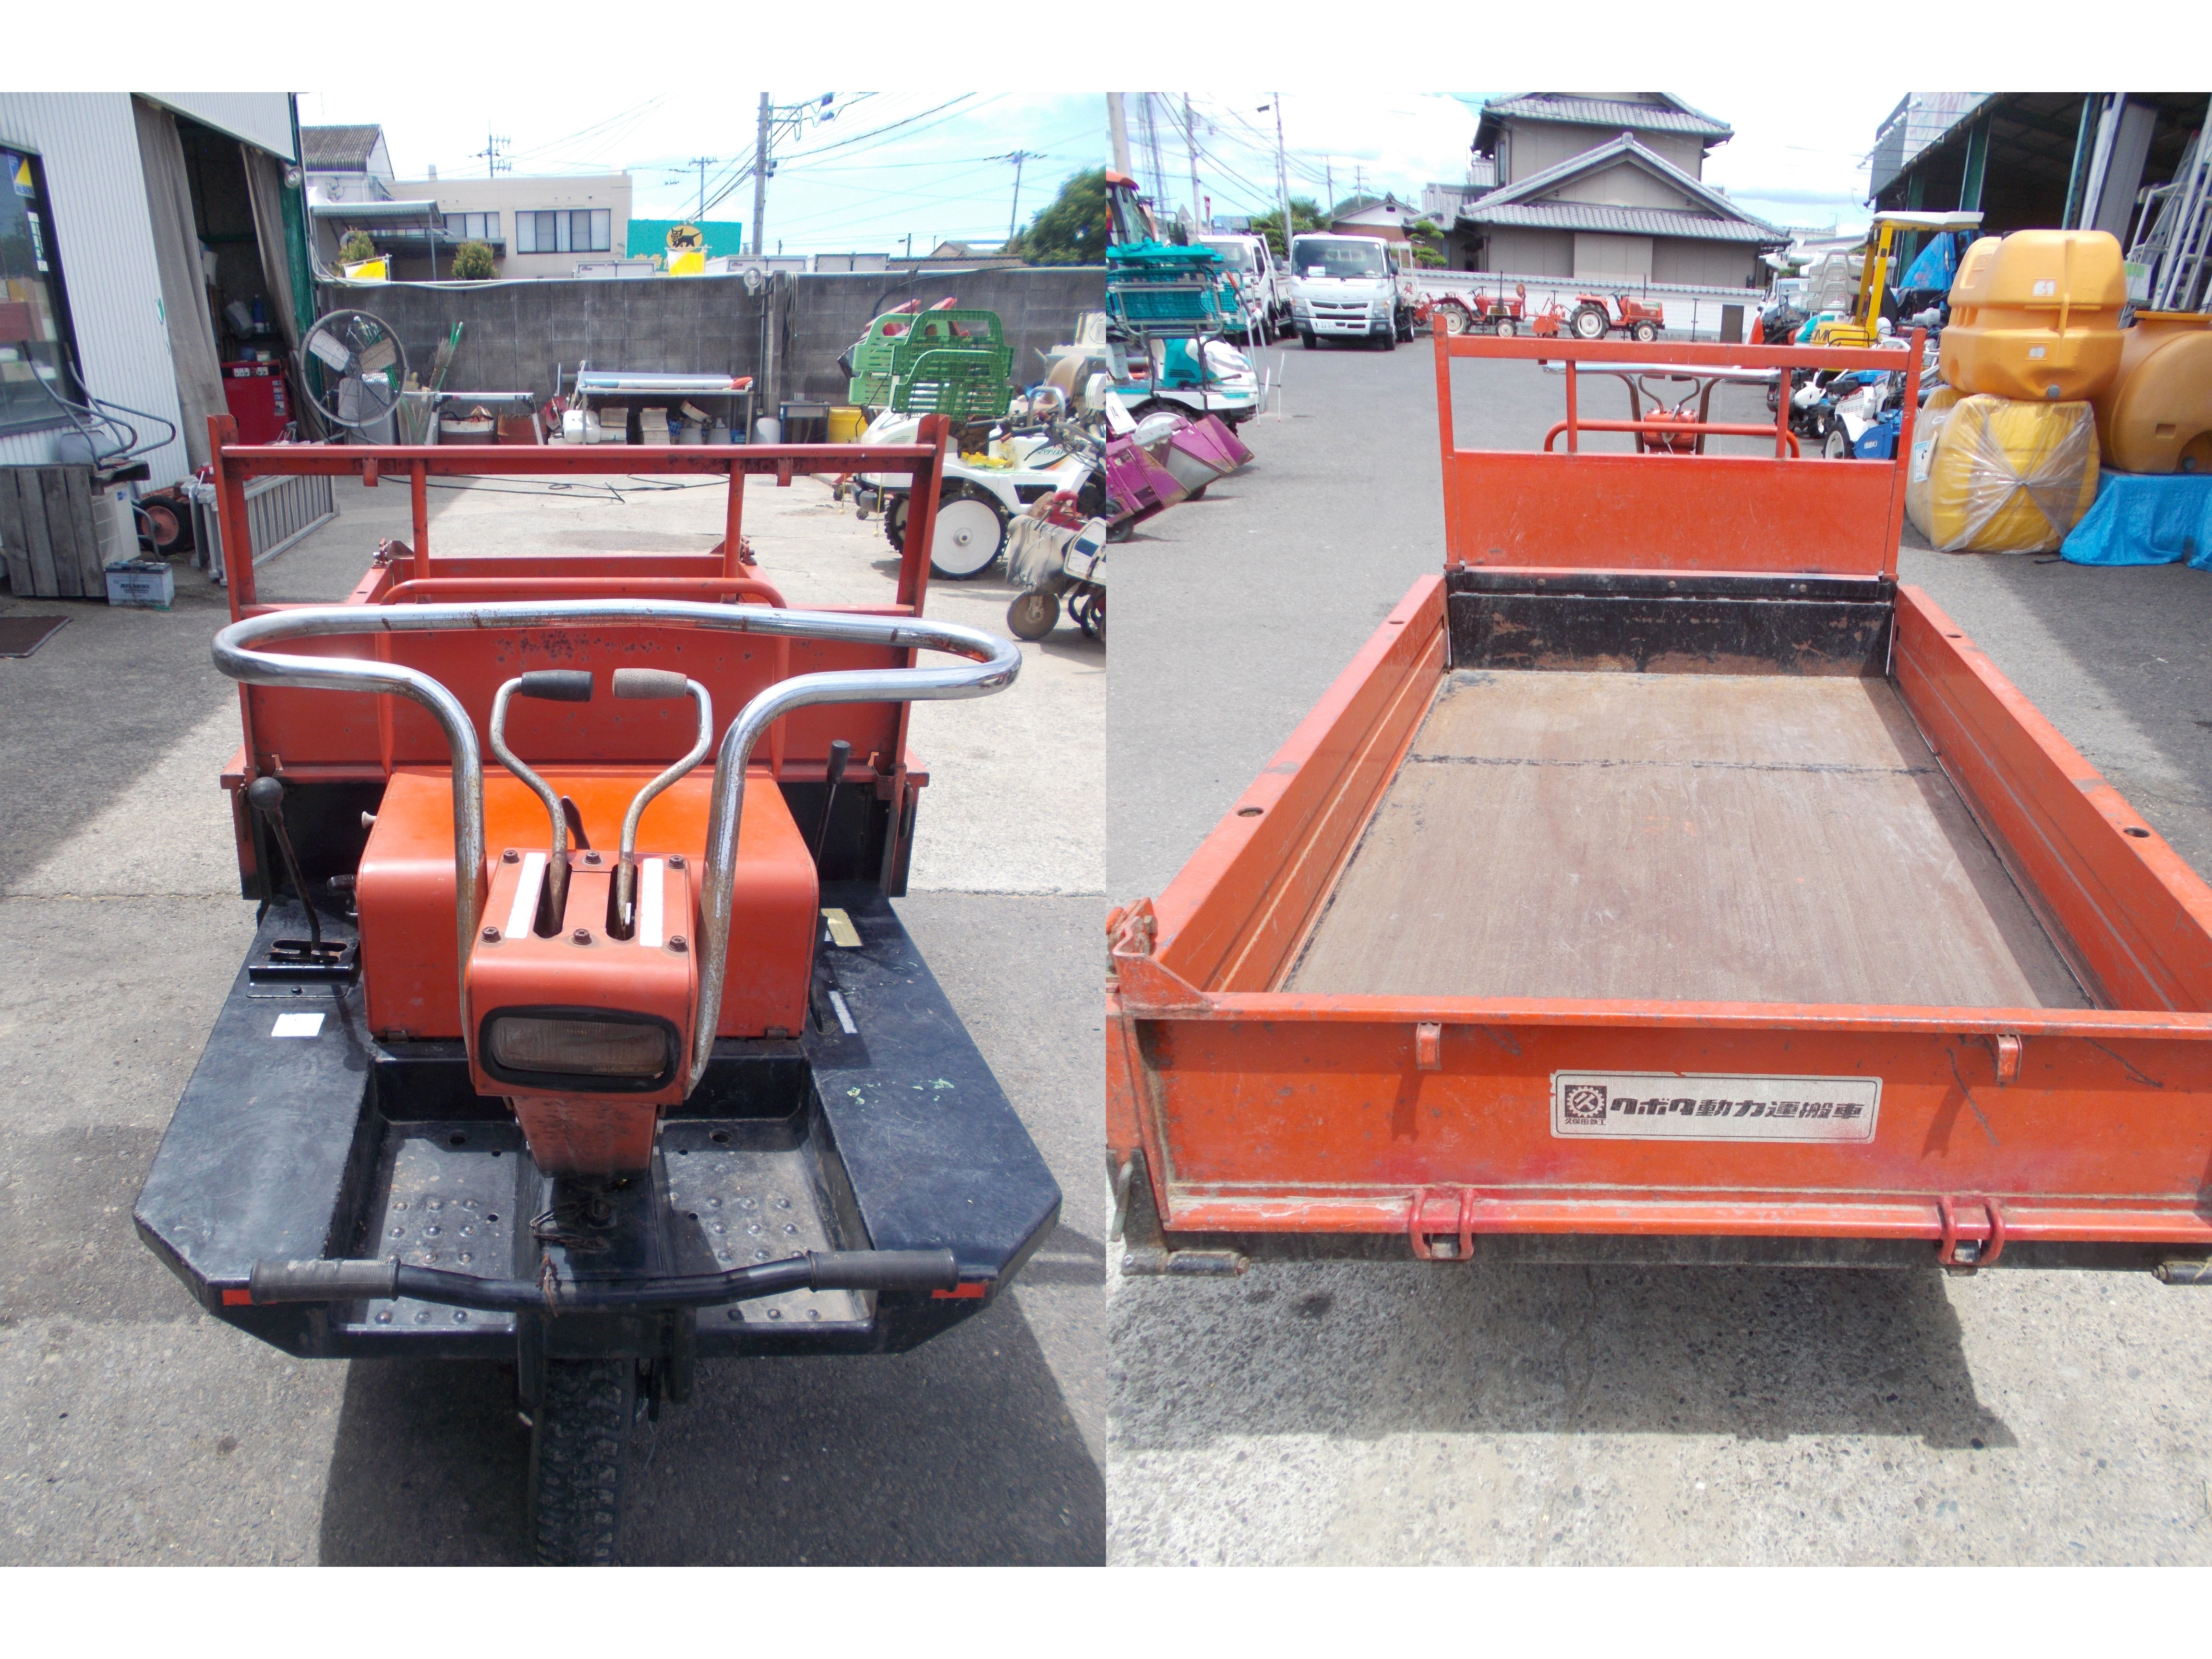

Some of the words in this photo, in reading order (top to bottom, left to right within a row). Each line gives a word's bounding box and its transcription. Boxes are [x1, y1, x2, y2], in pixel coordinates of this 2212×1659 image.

[1864, 441, 1877, 449] ISEKI
[1610, 1097, 1865, 1119] クボタ動力運搬車
